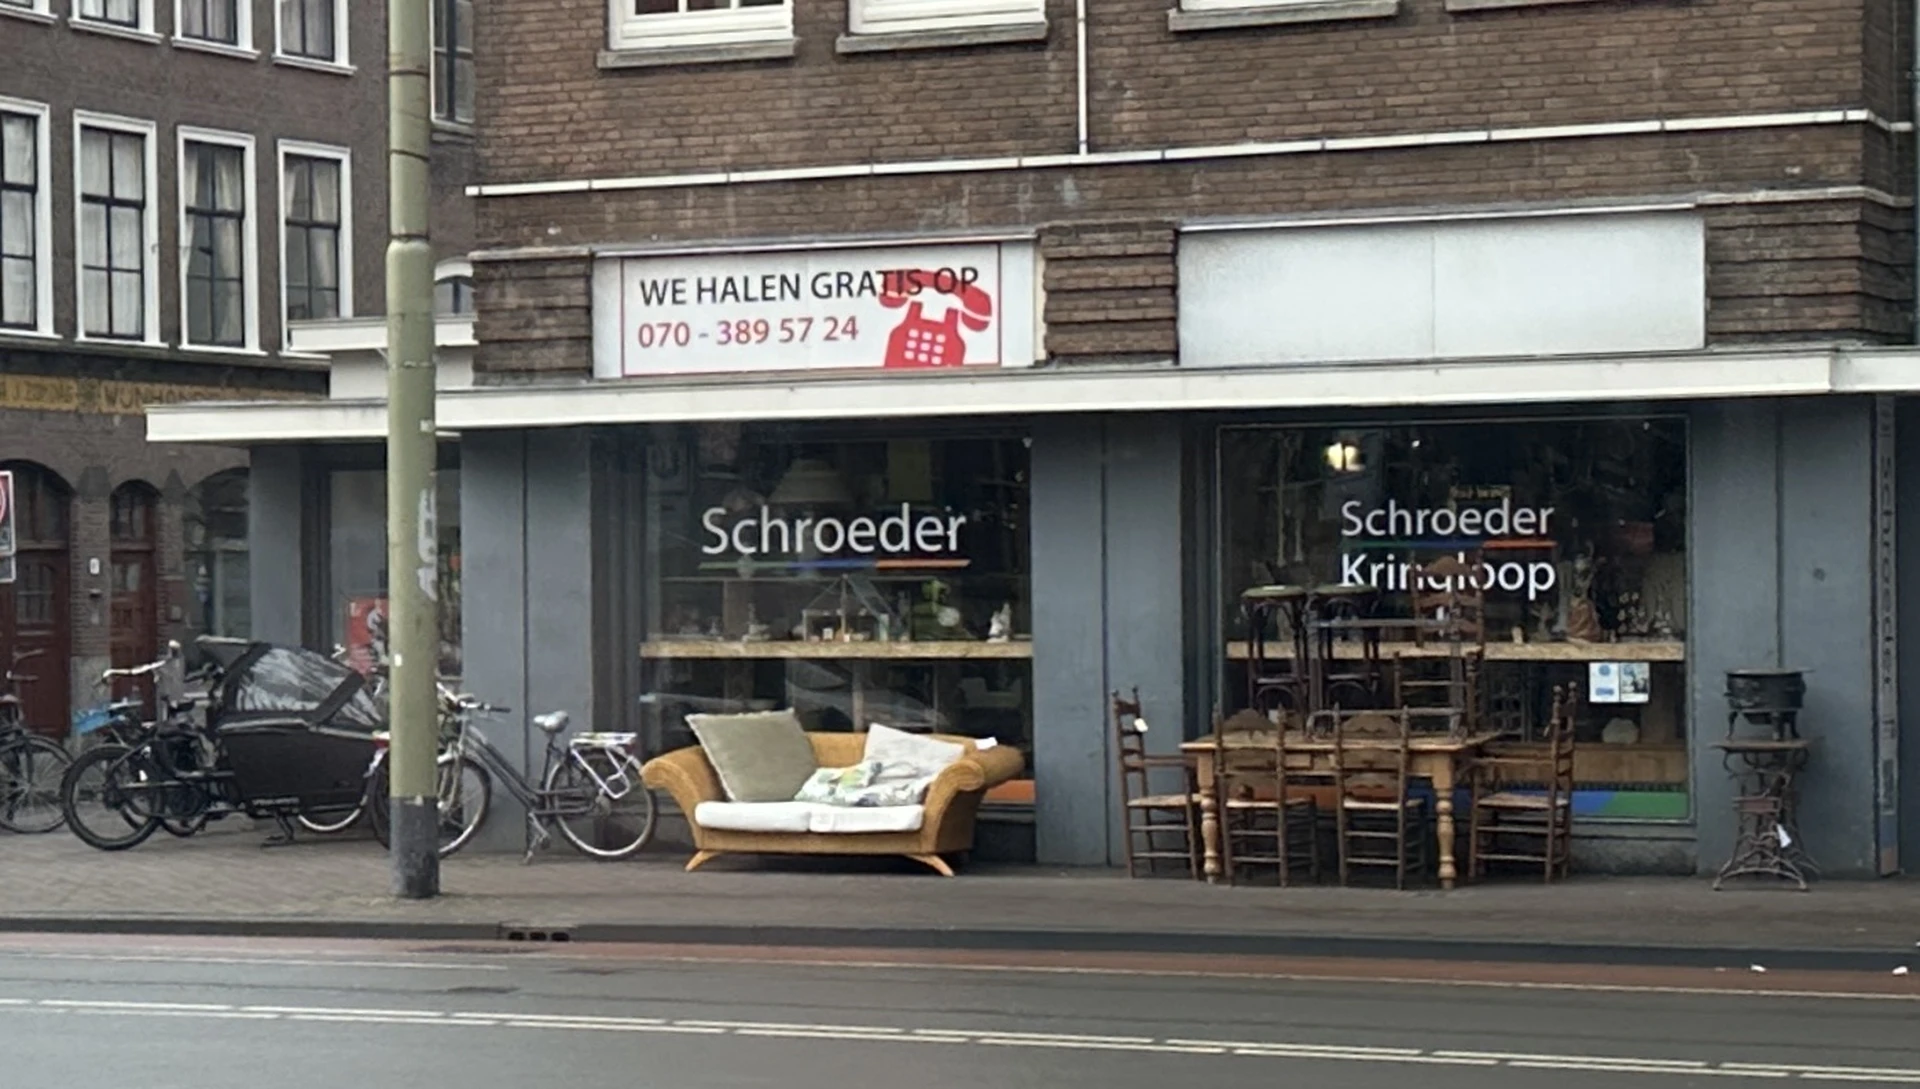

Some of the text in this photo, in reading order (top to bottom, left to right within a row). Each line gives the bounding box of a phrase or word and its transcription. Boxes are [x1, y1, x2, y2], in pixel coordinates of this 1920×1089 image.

[639, 266, 979, 307] WE HALEN GRATIS OP
[638, 322, 690, 349] 070
[716, 319, 769, 346] 389
[779, 317, 813, 343] 57
[823, 315, 859, 342] 24
[701, 502, 967, 554] Schroeder
[1341, 498, 1555, 537] Schroeder
